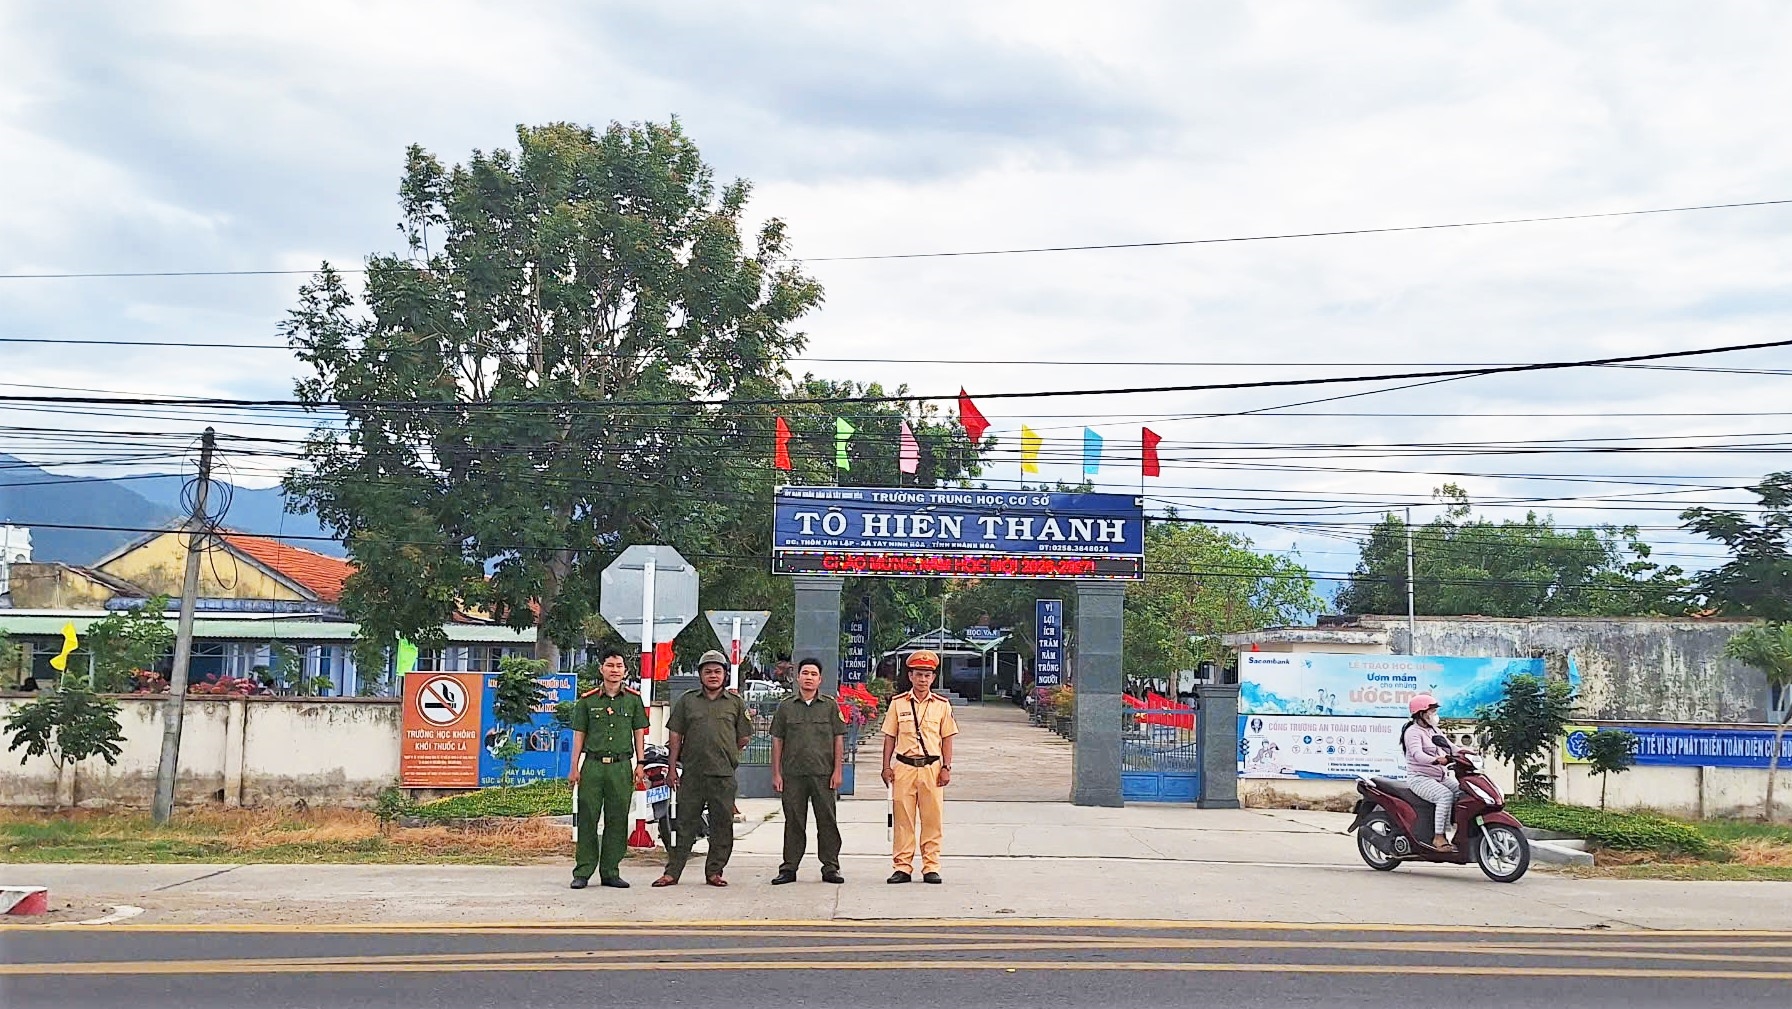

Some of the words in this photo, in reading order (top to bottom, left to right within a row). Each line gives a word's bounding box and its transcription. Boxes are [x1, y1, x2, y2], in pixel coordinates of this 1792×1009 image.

[871, 492, 924, 503] TRƯỜNG
[930, 493, 972, 504] TRUNG
[977, 495, 1003, 507] HỌC
[1009, 496, 1027, 505] CƠ
[1032, 493, 1050, 505] SỞ
[794, 506, 847, 536] TÔ
[861, 506, 964, 539] HIẾN
[1045, 602, 1053, 612] VÌ
[1043, 615, 1055, 625] LỢI
[1043, 626, 1055, 635] ÍCH
[1039, 638, 1058, 647] TRĂM
[1041, 650, 1056, 660] NĂM
[1248, 656, 1290, 665] Sacombank
[1038, 661, 1059, 672] TRỒNG
[1362, 661, 1389, 670] TRAO
[1392, 662, 1413, 671] HỌC
[1038, 674, 1058, 684] NGƯỜI
[1367, 672, 1389, 681] Ươm
[1349, 685, 1392, 703] ước
[1319, 723, 1329, 732] AN
[1350, 724, 1367, 733] GIAO
[406, 729, 434, 739] TRƯỜNG
[436, 730, 451, 739] HỌC
[452, 729, 476, 739] KHÔNG
[415, 740, 431, 751] KHÓI
[434, 740, 456, 751] THUỐC
[458, 741, 467, 751] LÁ
[1647, 733, 1656, 755] TẾ
[1657, 733, 1665, 755] VÌ
[1666, 736, 1678, 759] SỰ
[1678, 734, 1699, 756] PHÁT
[1700, 732, 1721, 757] TRIỂN
[1724, 735, 1744, 757] TOÀN
[1745, 736, 1763, 761] DIỆN
